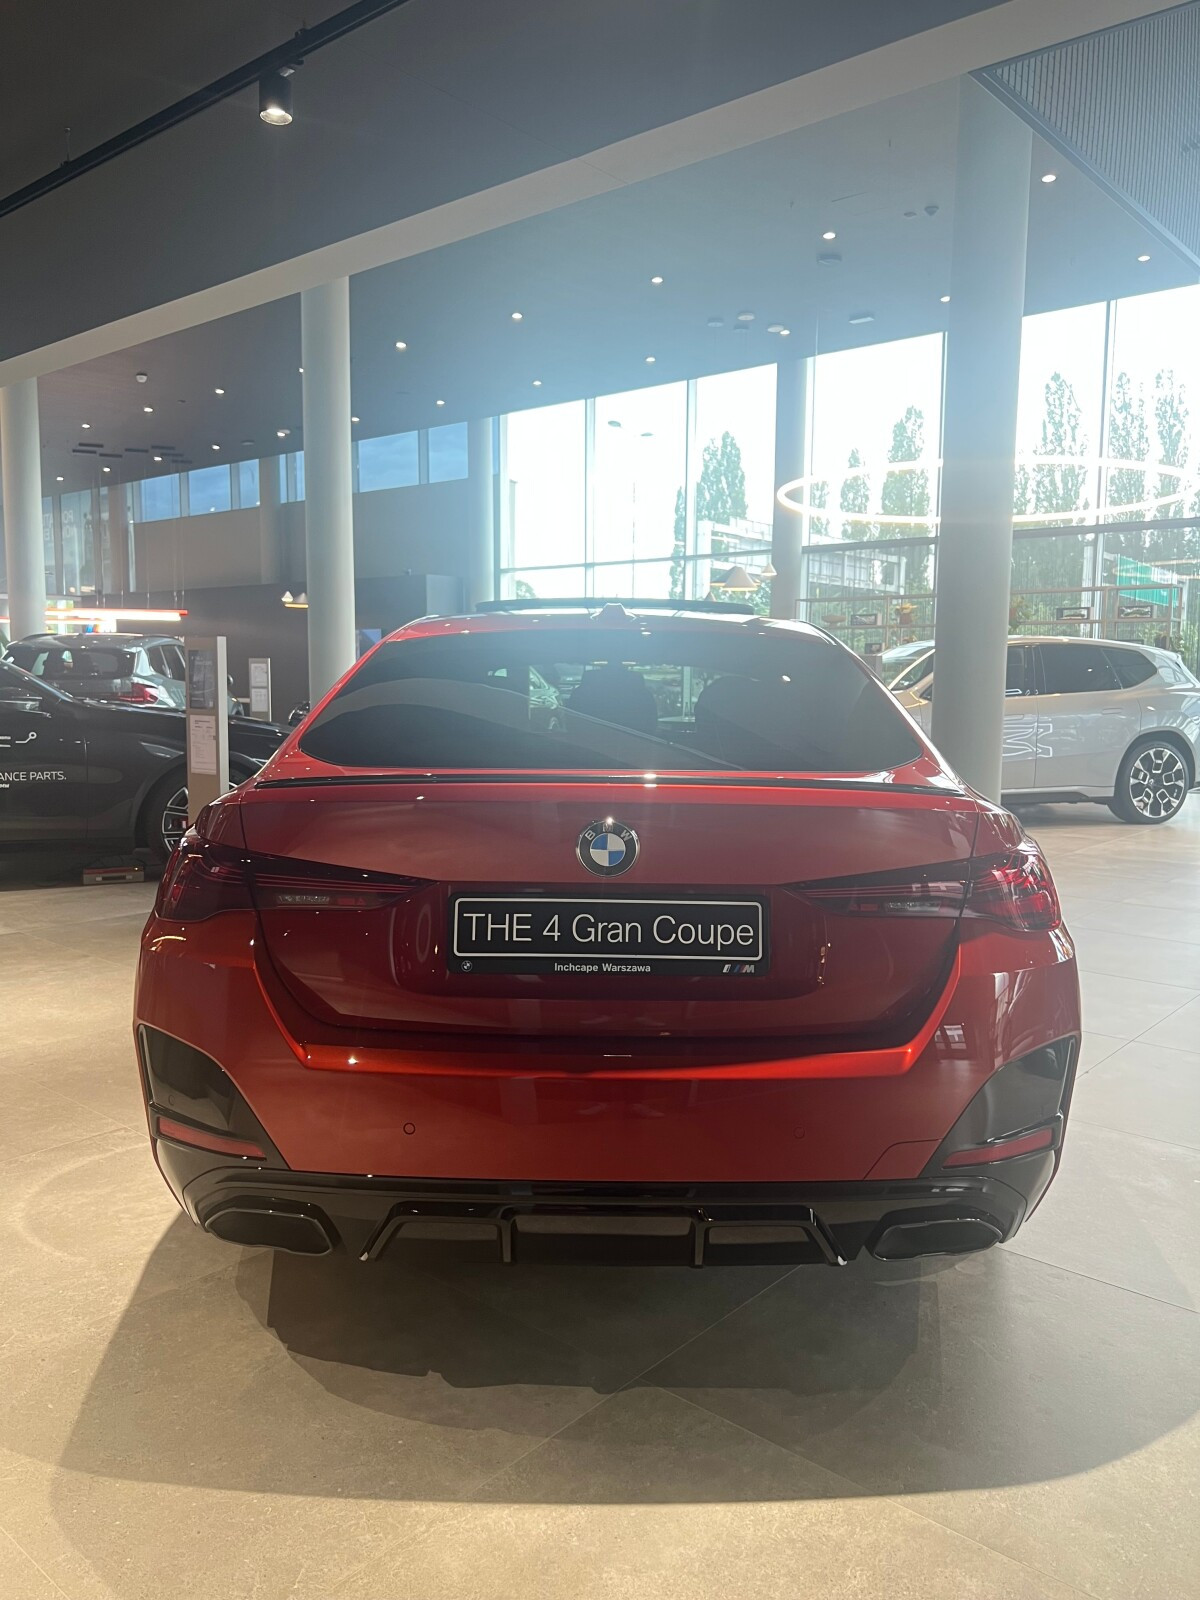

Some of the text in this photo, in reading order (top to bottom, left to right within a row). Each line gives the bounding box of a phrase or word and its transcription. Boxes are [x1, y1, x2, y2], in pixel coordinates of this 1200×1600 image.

[29, 770, 67, 781] PARTS.
[584, 822, 633, 842] BMW
[463, 913, 754, 951] THE 4 Gran Coupe
[554, 962, 651, 973] Inchcape Warszawa
